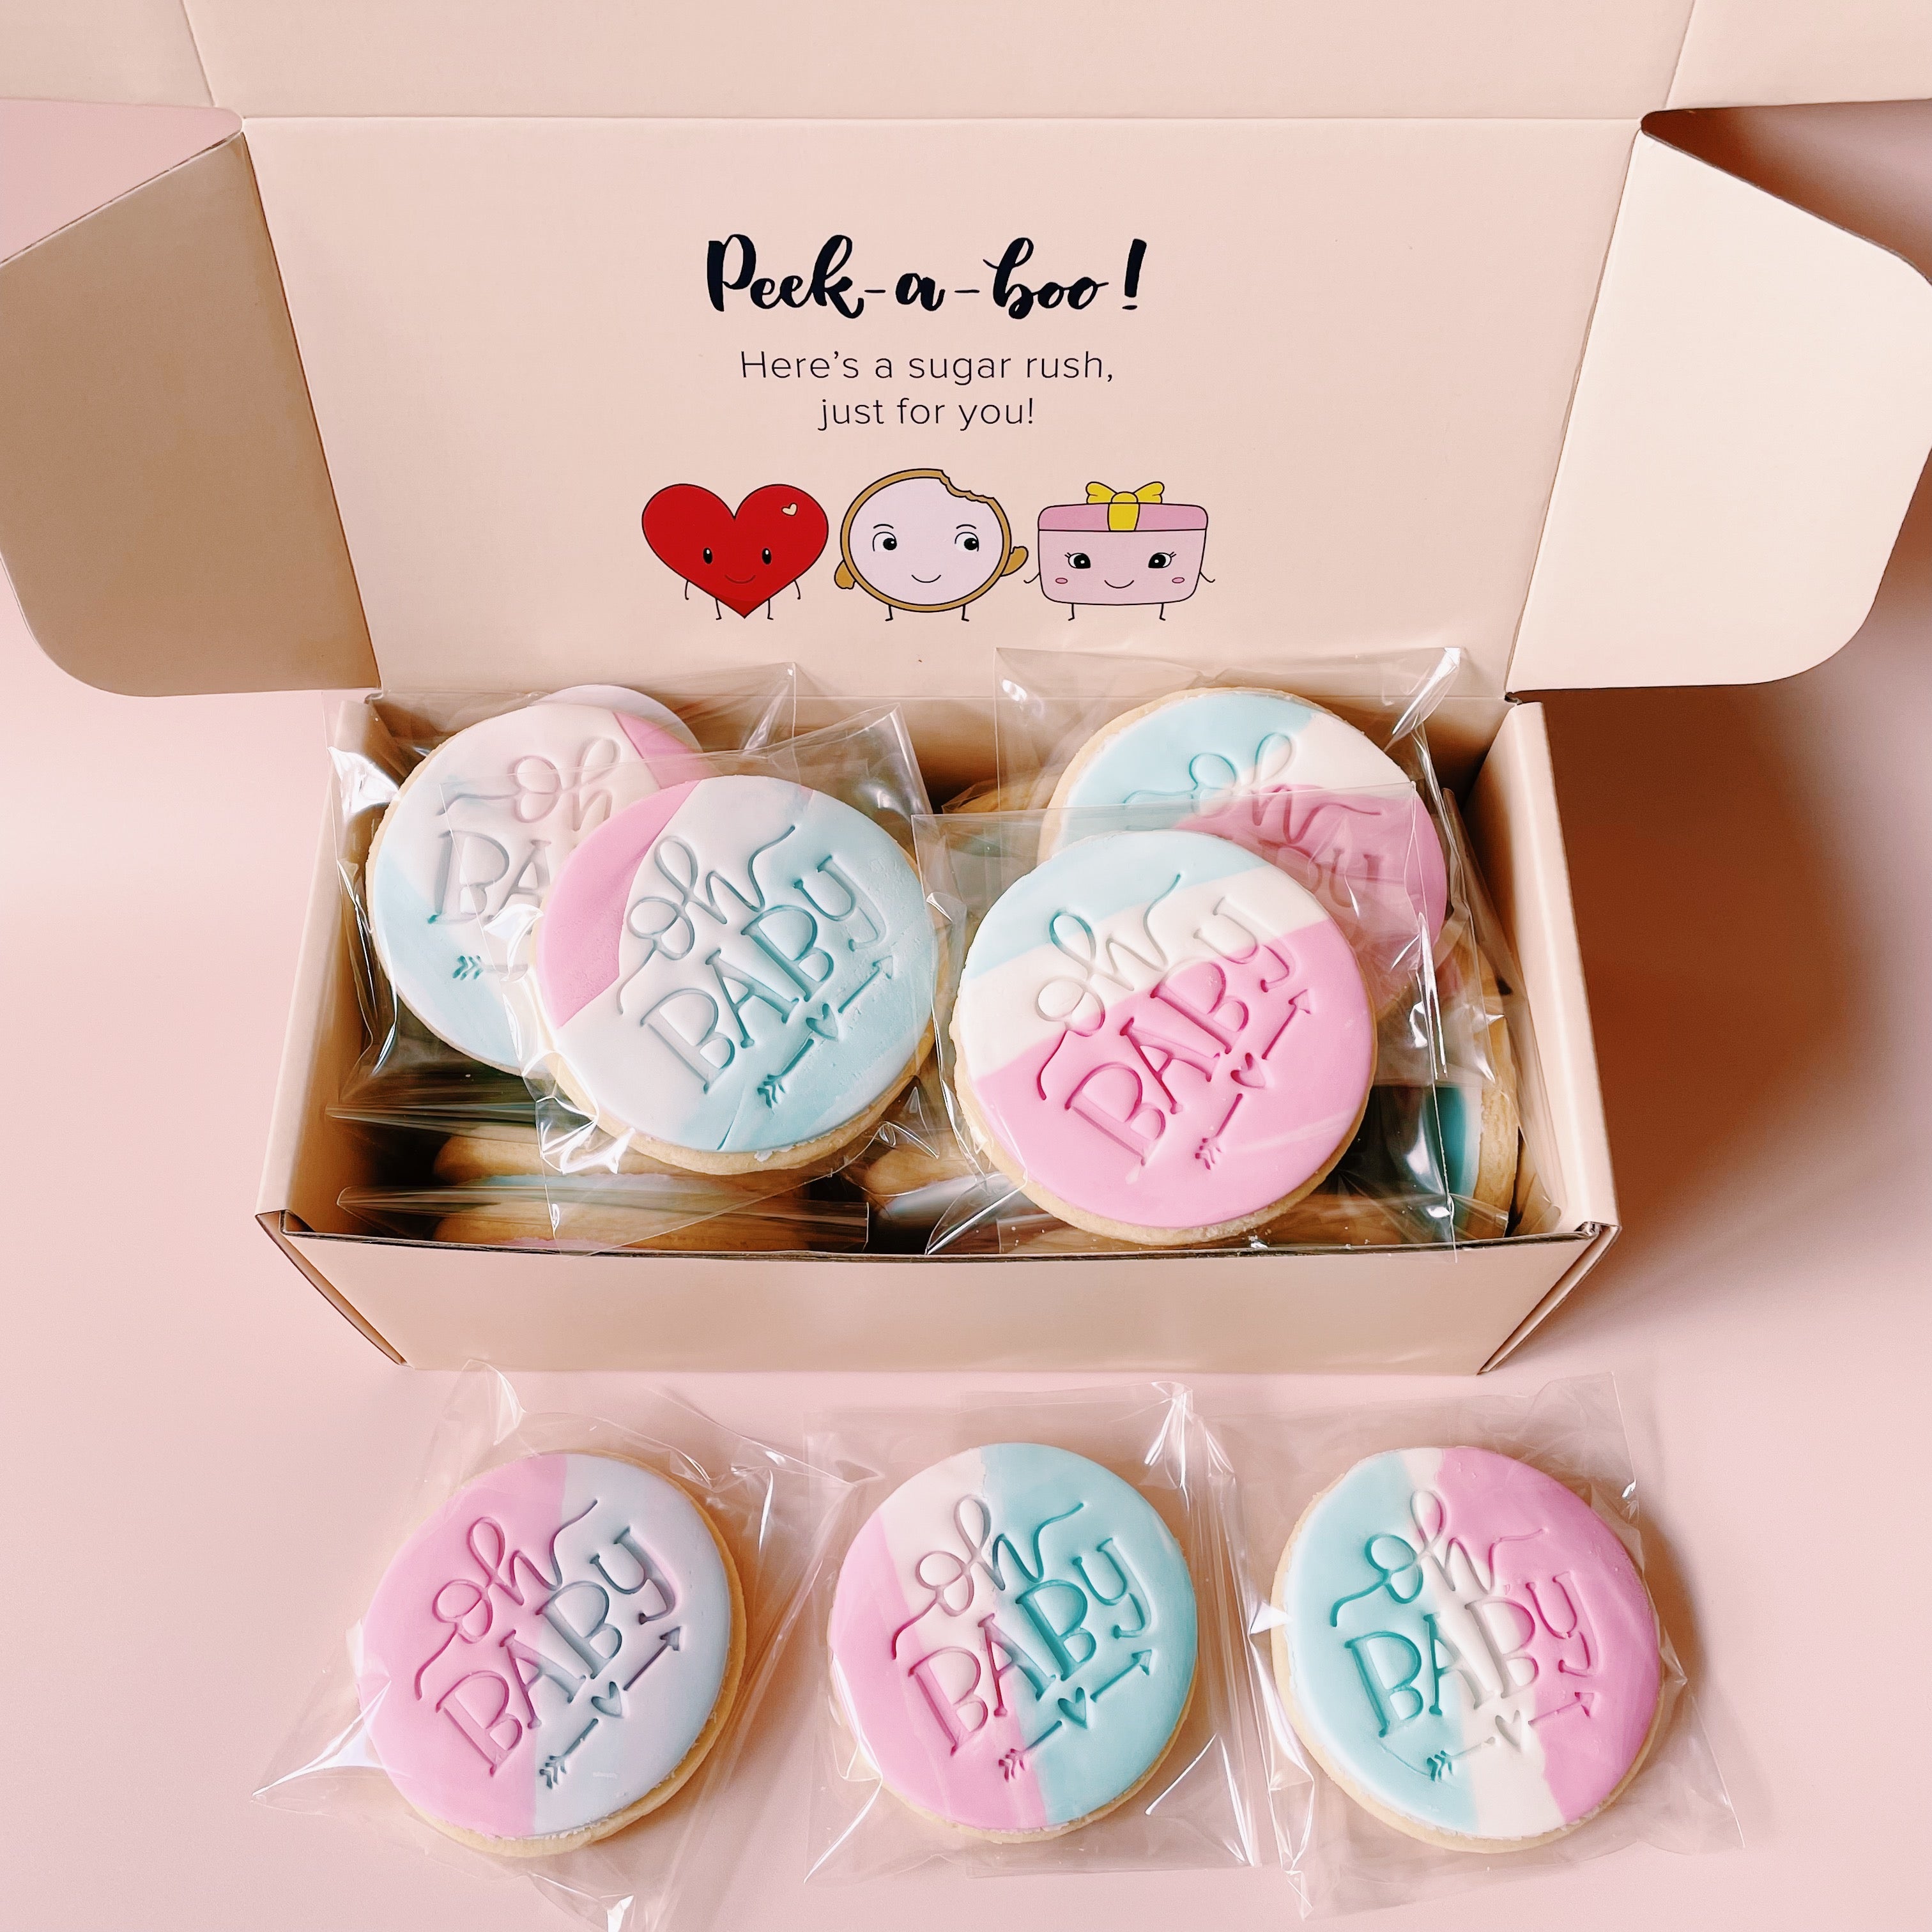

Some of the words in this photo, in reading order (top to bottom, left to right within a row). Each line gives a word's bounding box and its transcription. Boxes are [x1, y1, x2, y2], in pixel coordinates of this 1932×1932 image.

[740, 350, 859, 379] Here’s
[875, 358, 893, 379] a
[908, 357, 1011, 387] sugar
[1027, 351, 1113, 383] rush,
[817, 399, 885, 431] just
[896, 397, 946, 425] for
[958, 397, 1033, 431] you!
[617, 825, 796, 1015] oh
[1036, 871, 1184, 1101] oh
[414, 1498, 598, 1700] oh
[891, 1494, 1085, 1660] oh
[1331, 1489, 1548, 1627] oh
